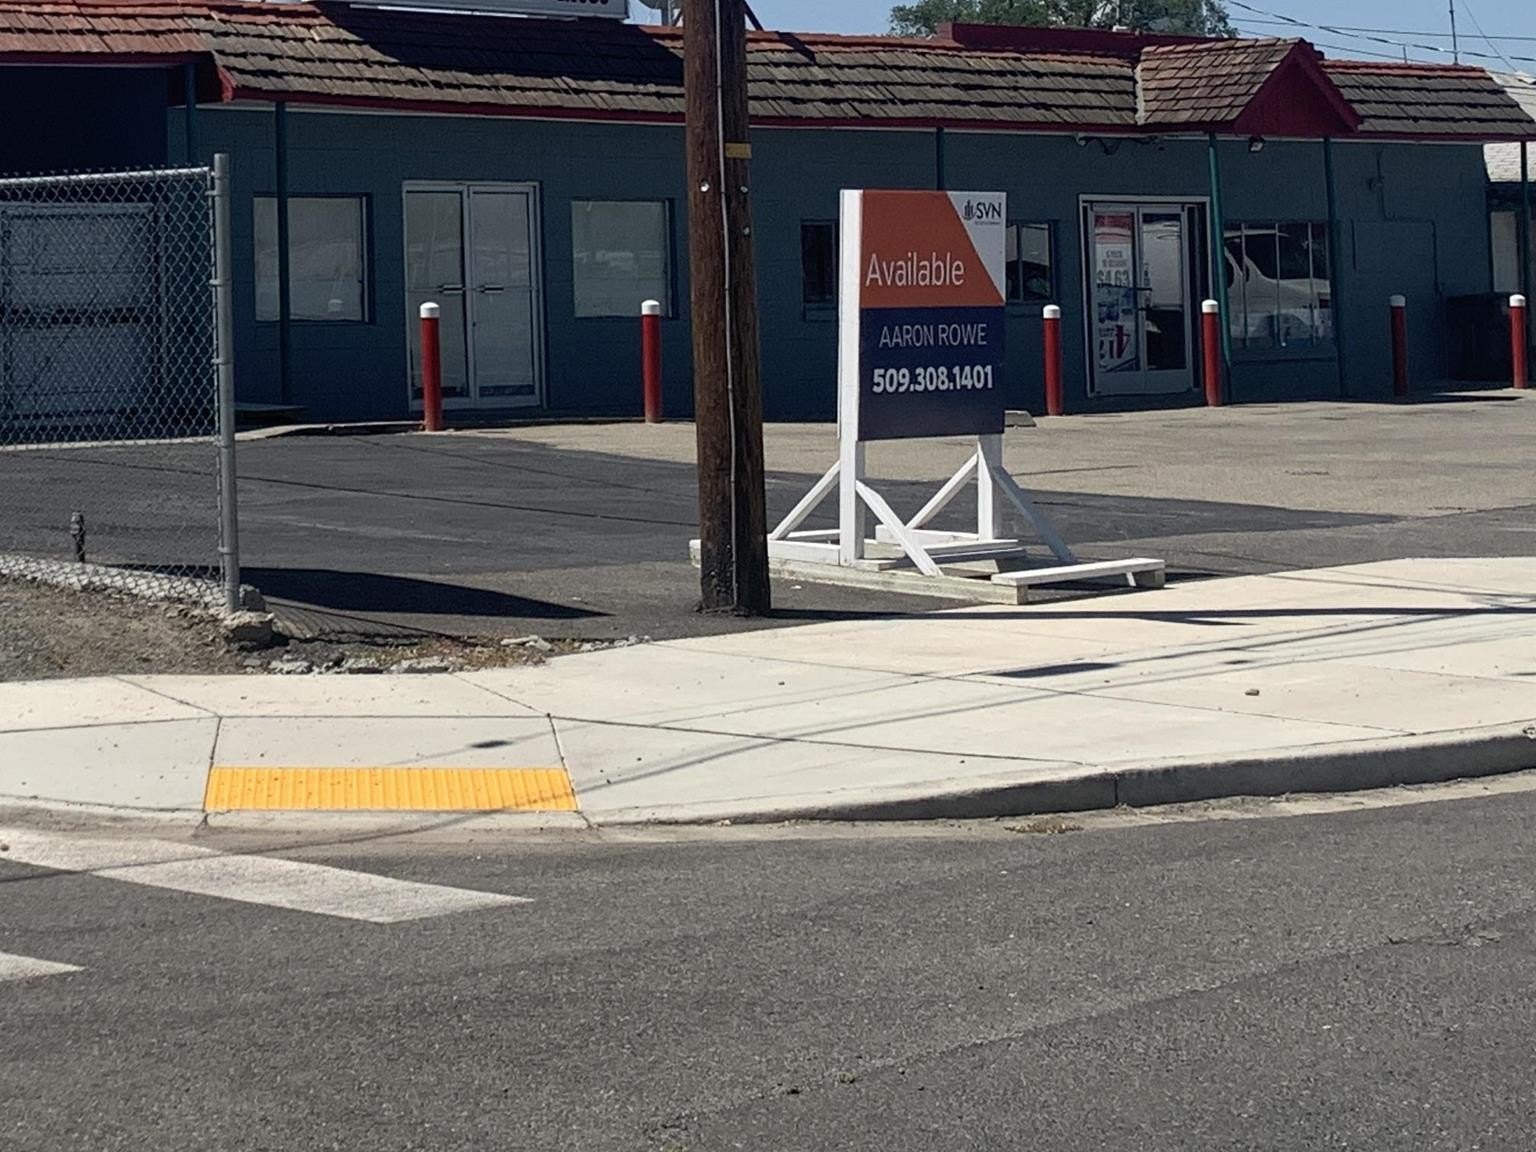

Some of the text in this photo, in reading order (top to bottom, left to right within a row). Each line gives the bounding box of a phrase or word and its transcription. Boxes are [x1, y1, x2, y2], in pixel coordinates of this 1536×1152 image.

[976, 202, 1002, 219] SVN
[865, 252, 965, 286] Available
[879, 323, 987, 348] AARON ROWE
[872, 365, 993, 393] 509.308.1401
